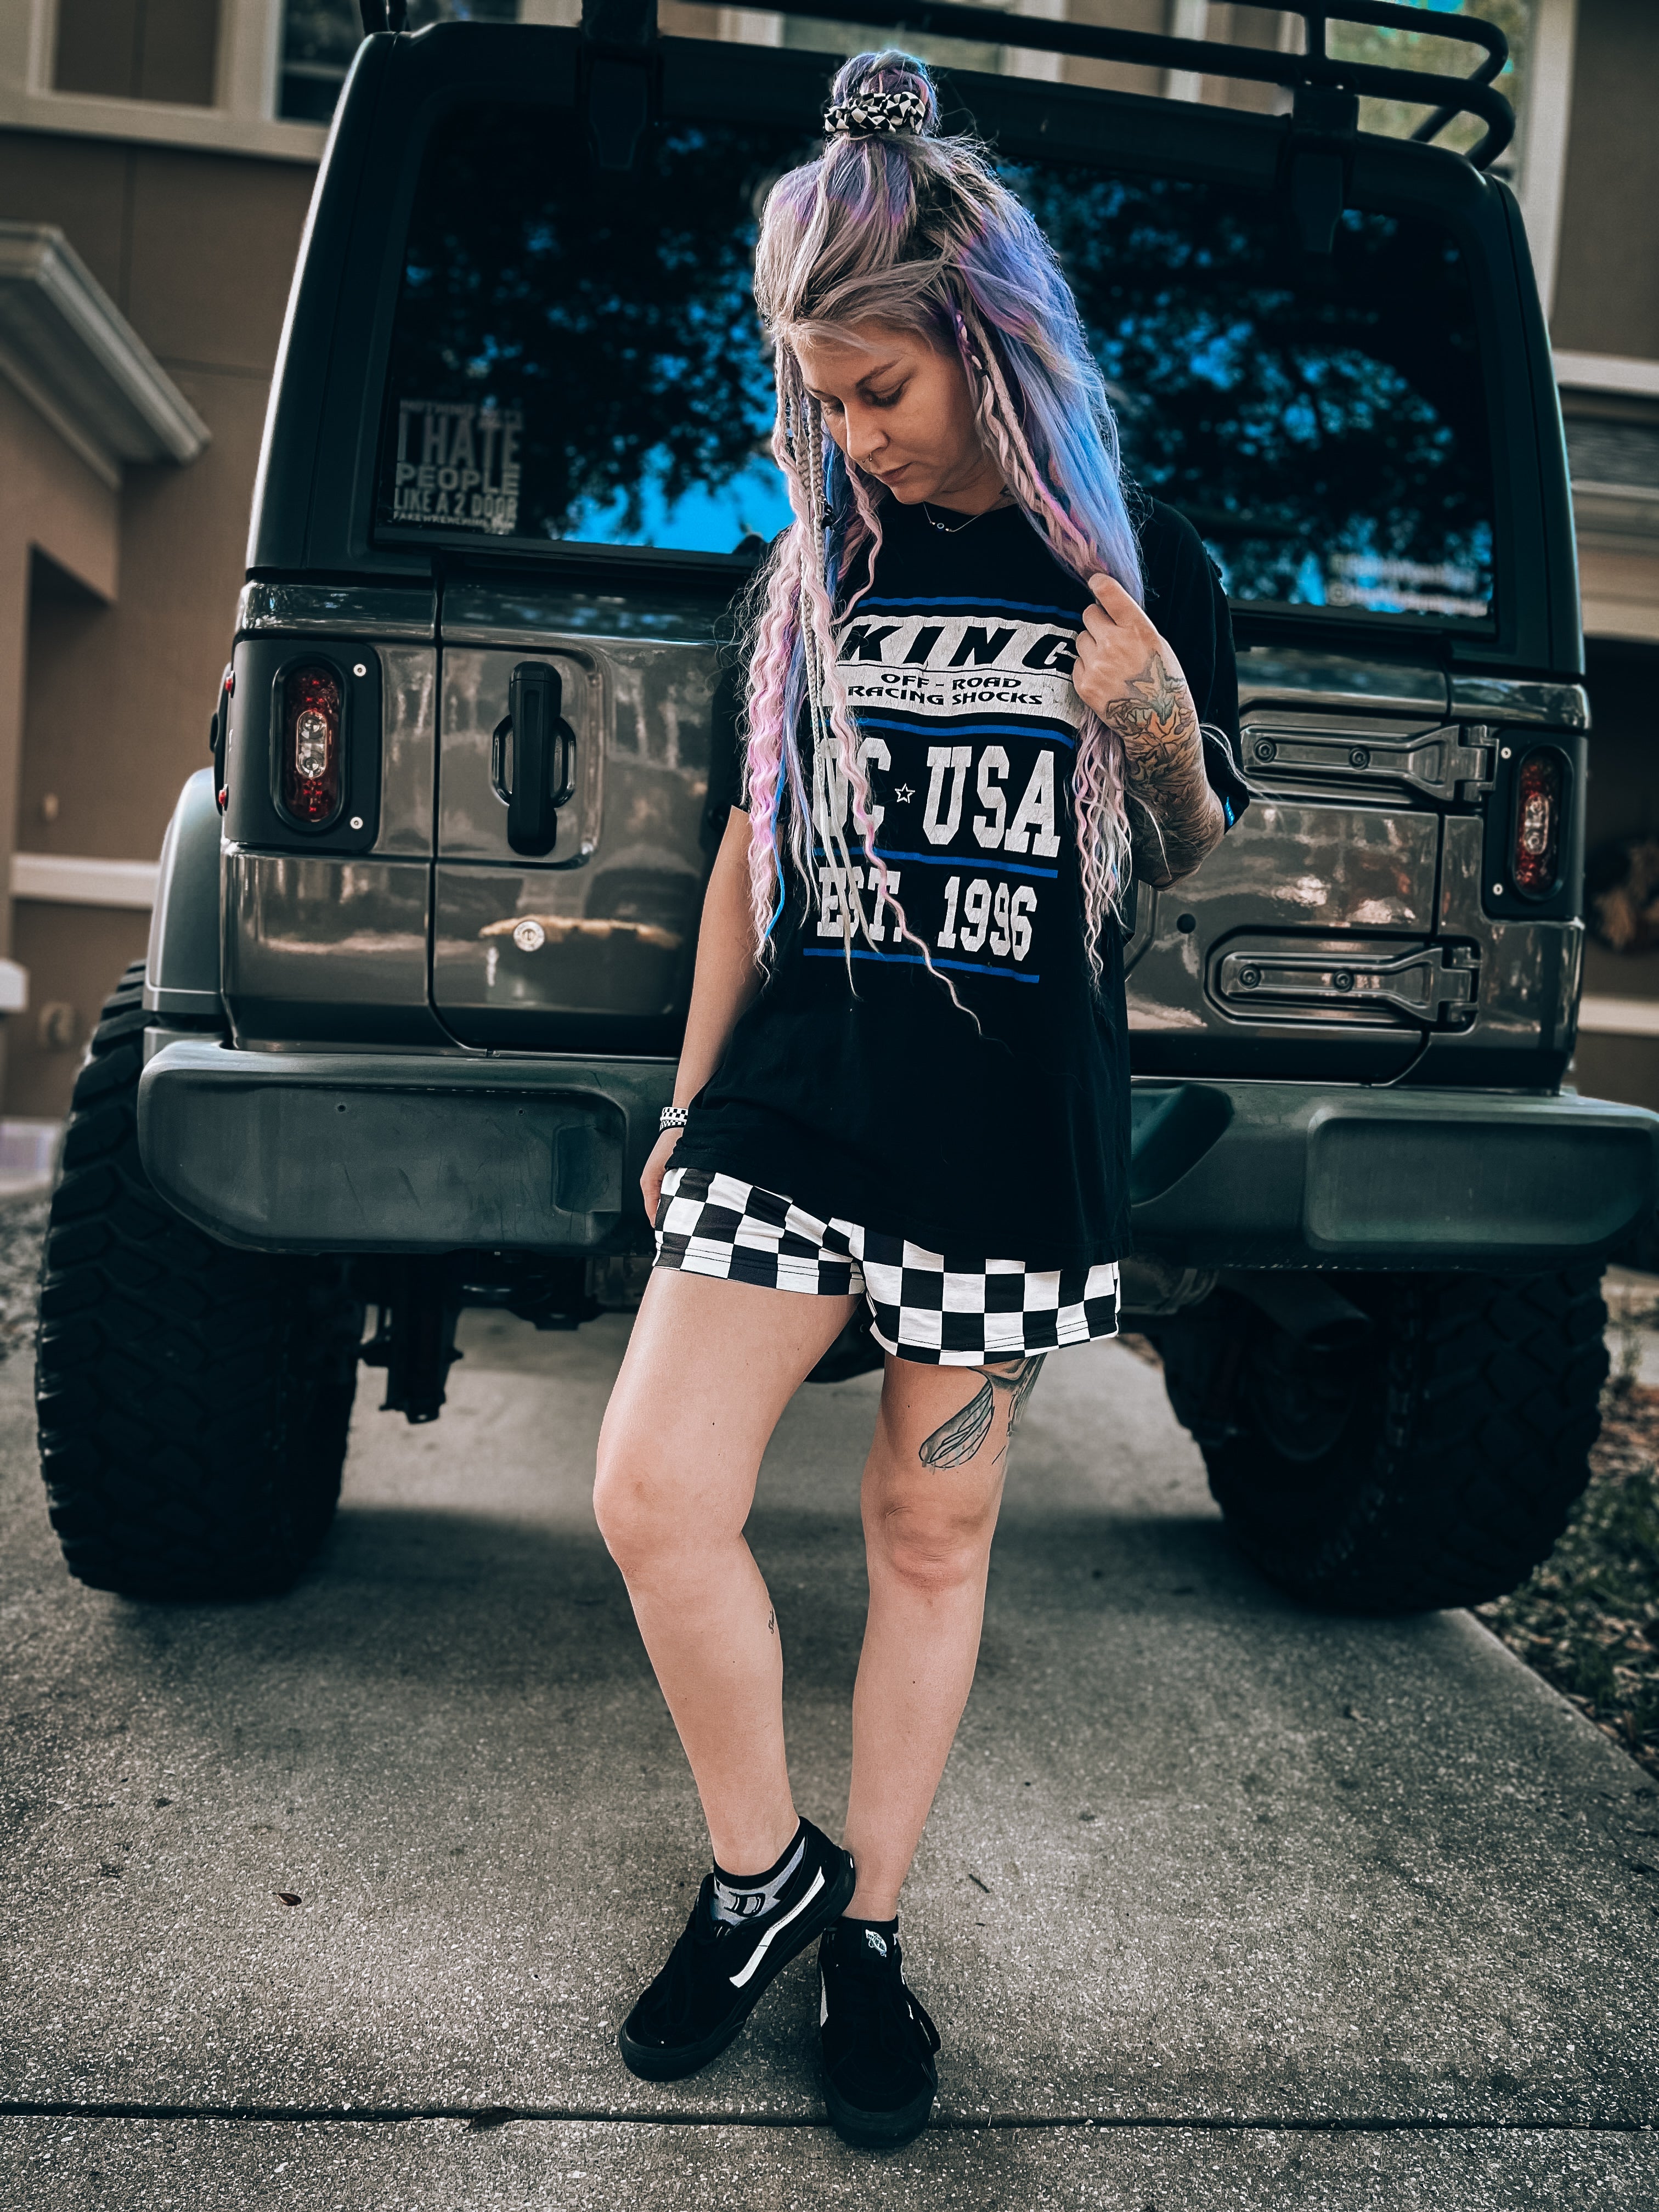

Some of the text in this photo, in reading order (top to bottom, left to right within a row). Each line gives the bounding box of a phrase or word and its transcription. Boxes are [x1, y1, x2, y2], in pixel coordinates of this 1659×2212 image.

[397, 413, 409, 462] I
[422, 414, 520, 468] HATE
[396, 463, 520, 495] PEOPLE
[394, 487, 518, 520] LIKE A 2 DOOR
[839, 624, 1080, 674] KING
[848, 685, 1043, 706] RACING SHOCKS
[881, 673, 929, 689] OFF
[952, 673, 1022, 690] ROAD
[923, 746, 1060, 857] USA
[937, 876, 1037, 961] 1996
